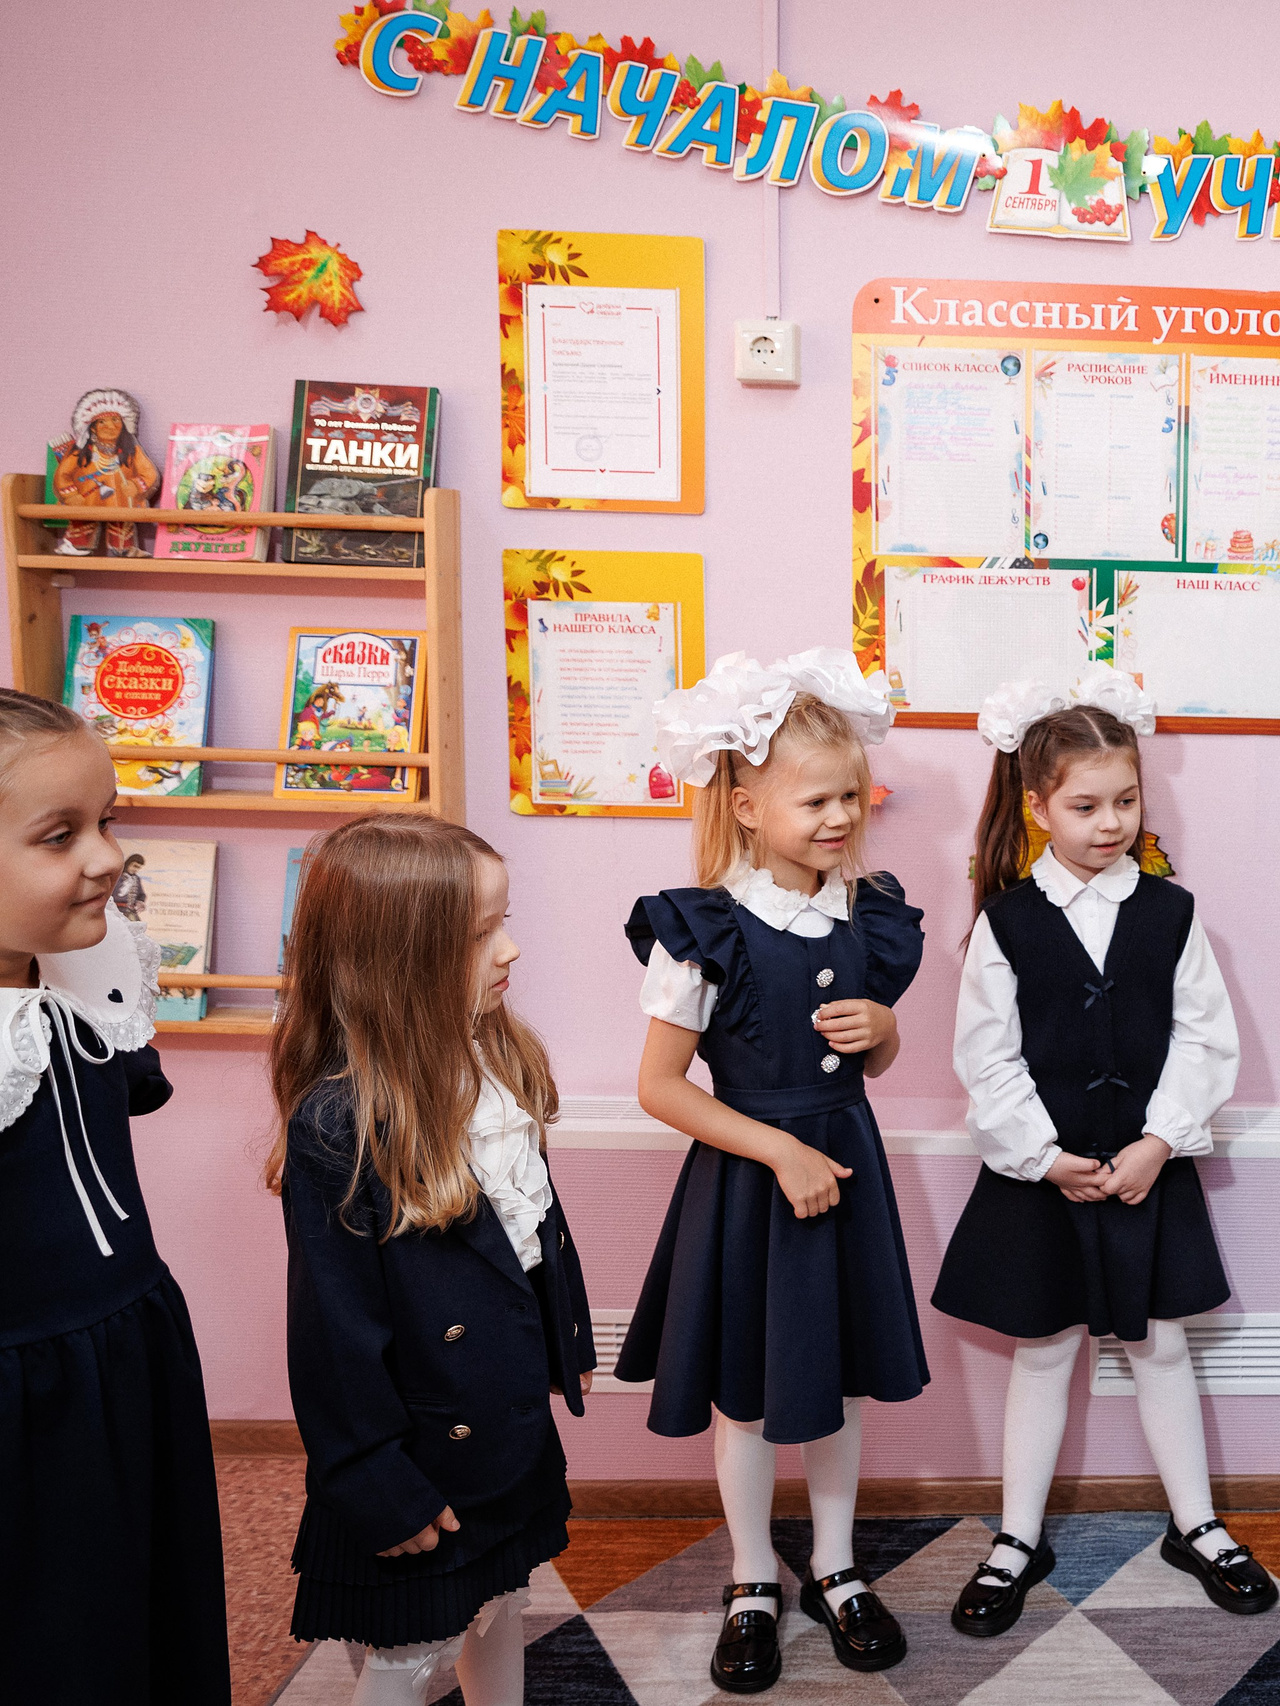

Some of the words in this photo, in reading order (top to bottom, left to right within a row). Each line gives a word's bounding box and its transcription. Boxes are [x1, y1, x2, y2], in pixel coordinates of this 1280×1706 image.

[361, 10, 443, 97] С
[455, 27, 986, 213] НАЧАЛОМ
[1019, 158, 1047, 196] 1
[1004, 195, 1058, 212] СЕНТЯБРЯ
[890, 285, 1140, 332] Классный
[902, 362, 951, 372] СПИСОК
[954, 363, 1000, 373] КЛАССА
[1067, 363, 1149, 375] РАСПИСАНИЕ
[882, 367, 899, 386] 5
[1082, 375, 1133, 386] УРОКОВ
[1161, 416, 1176, 433] 5
[306, 437, 420, 469] ТАНКИ
[922, 573, 975, 585] ГРАФИК
[978, 575, 1051, 586] ДЕЖУРСТВ
[1176, 578, 1209, 590] НАШ
[1214, 580, 1261, 592] КЛАСС
[574, 612, 631, 623] ПРАВИЛА
[553, 623, 605, 633] НАШЕГО
[608, 624, 657, 634] КЛАССА
[116, 660, 165, 676] Добрые
[357, 666, 390, 681] Перро
